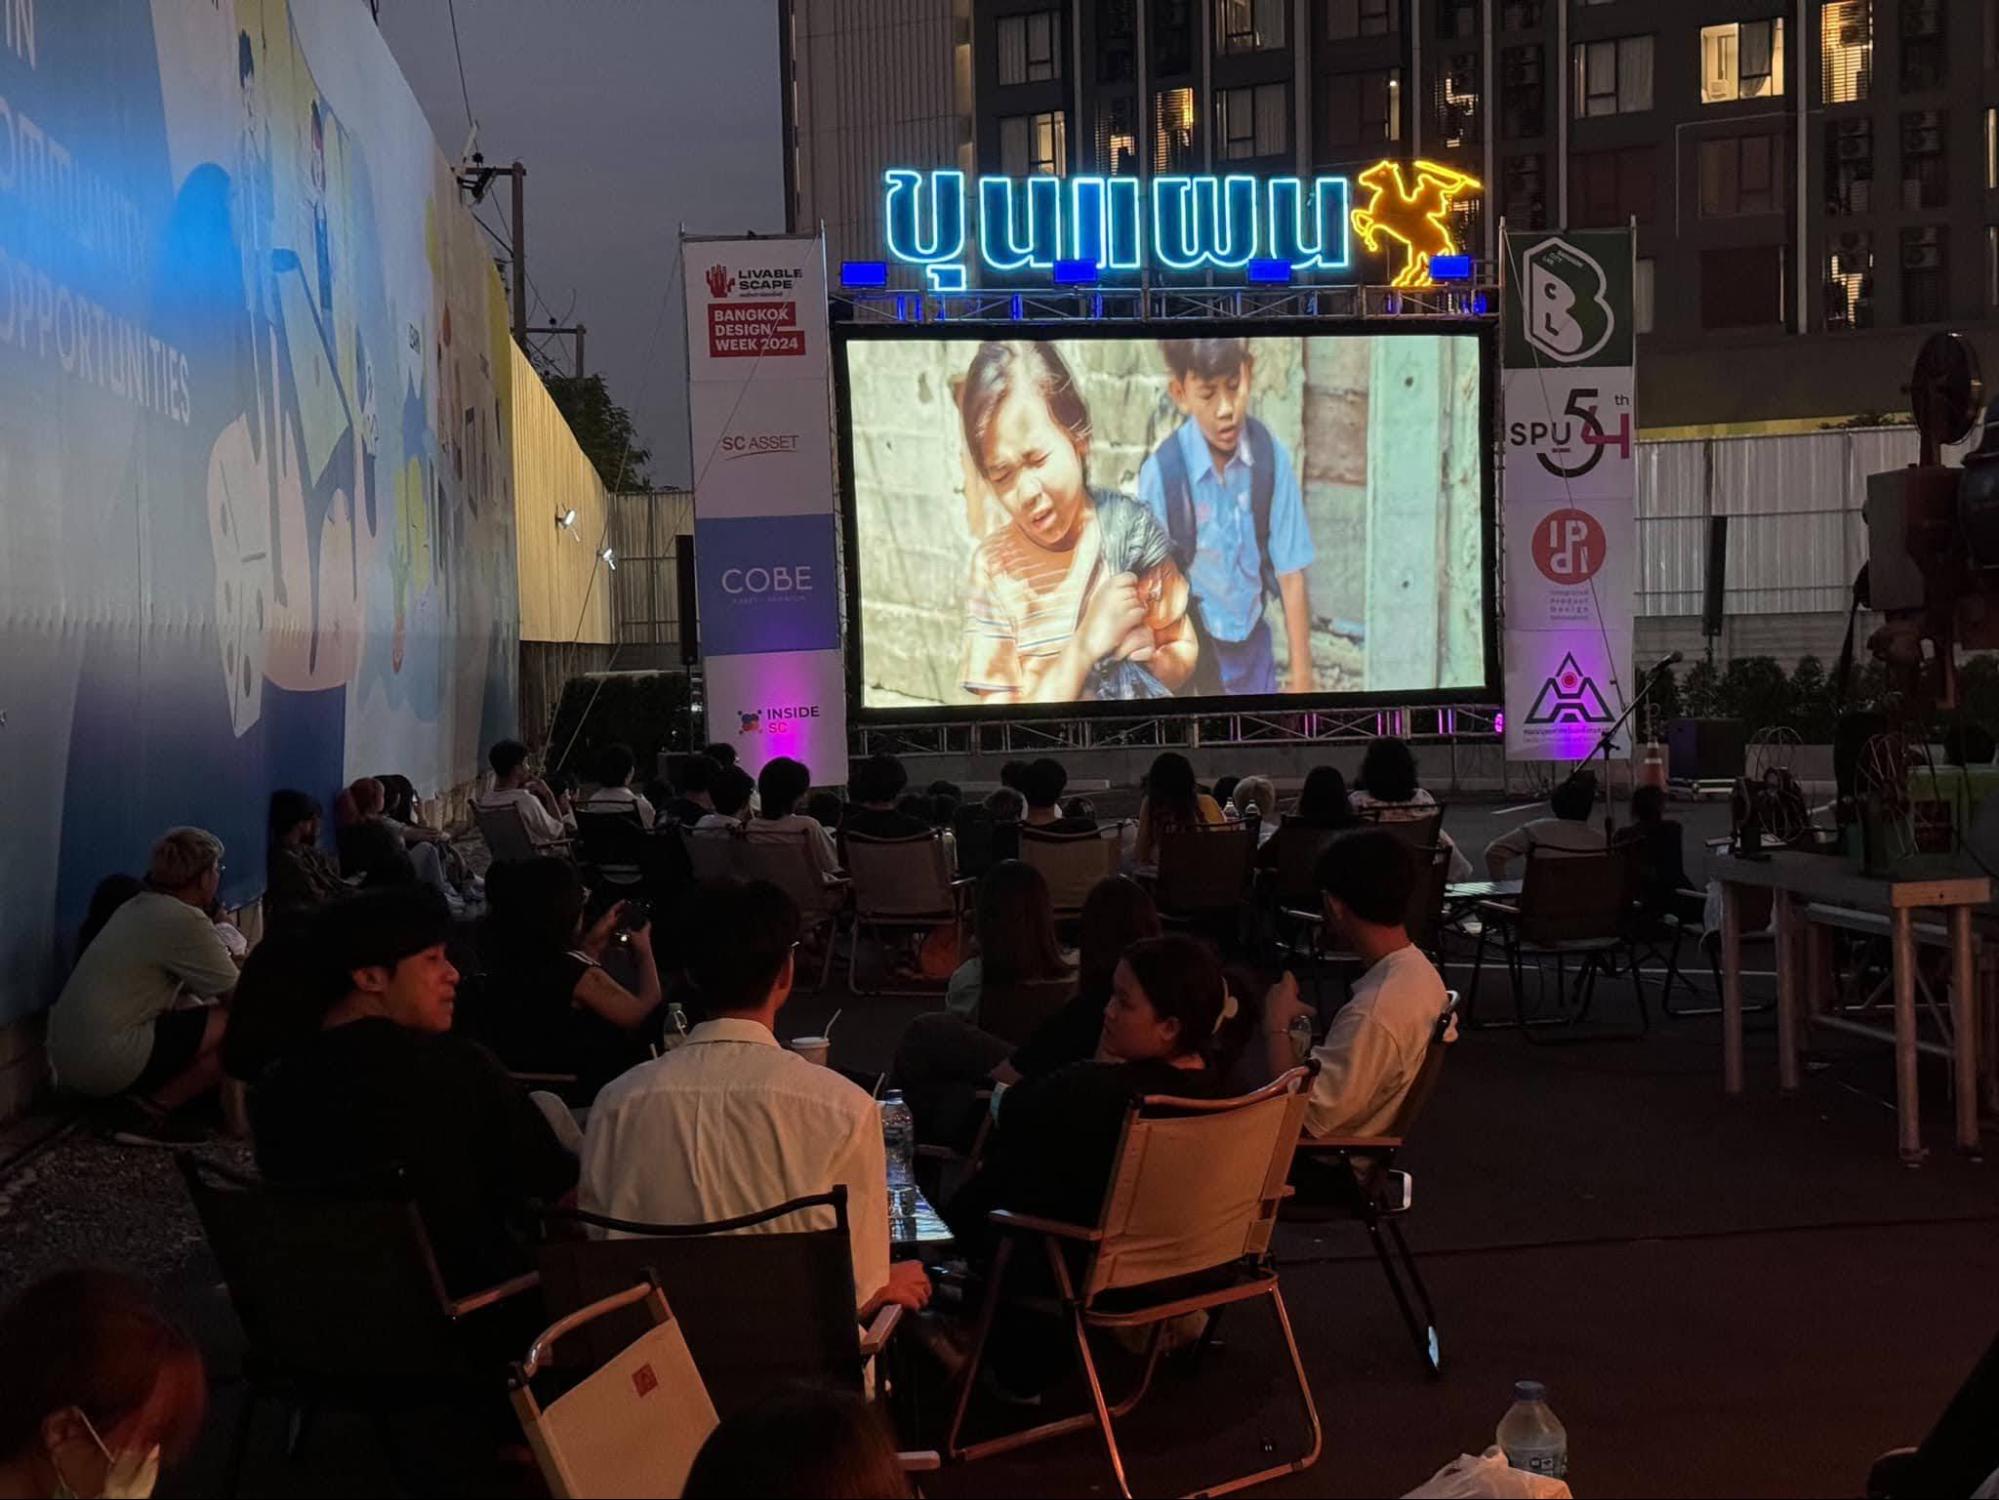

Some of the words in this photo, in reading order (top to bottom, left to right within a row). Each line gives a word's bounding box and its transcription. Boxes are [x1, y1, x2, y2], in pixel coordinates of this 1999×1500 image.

[738, 268, 803, 279] LIVABLE
[738, 279, 793, 290] SCAPE
[714, 308, 788, 321] BANGKOK
[715, 324, 771, 336] DESIGN
[715, 338, 756, 351] WEEK
[760, 337, 798, 350] 2024
[1510, 421, 1571, 446] SPU
[722, 437, 746, 450] SC
[748, 435, 799, 449] ASSET
[721, 566, 813, 593] COBE
[767, 706, 820, 720] INSIDE
[768, 723, 788, 734] SC
